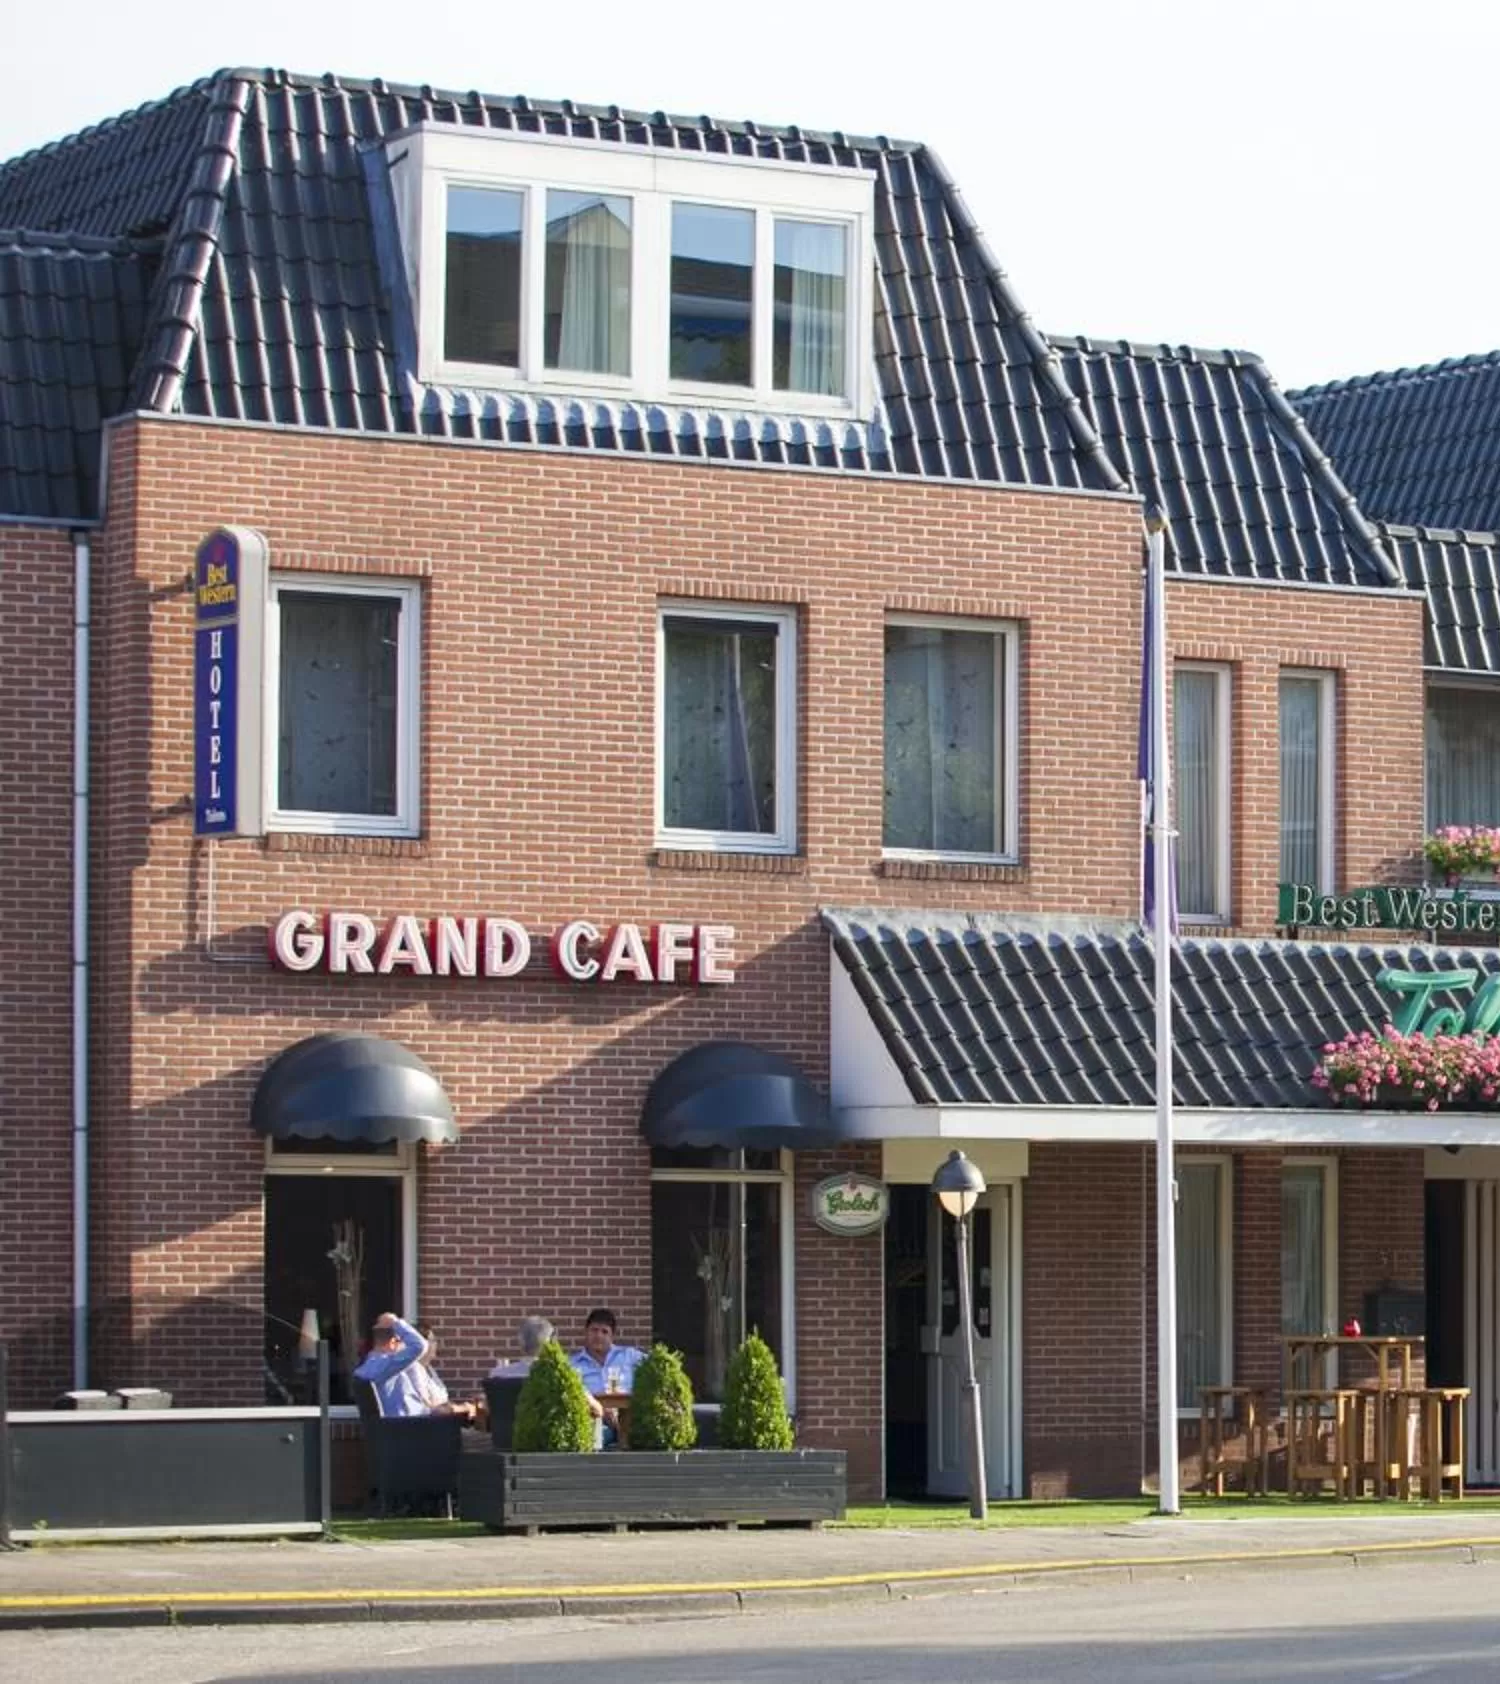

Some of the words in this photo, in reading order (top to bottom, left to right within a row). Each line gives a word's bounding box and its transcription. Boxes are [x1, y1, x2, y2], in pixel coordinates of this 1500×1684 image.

[207, 562, 227, 586] Best
[209, 630, 223, 800] HOTEL
[1291, 884, 1381, 928] Best
[272, 910, 531, 978] GRAND
[554, 919, 736, 984] CAFE
